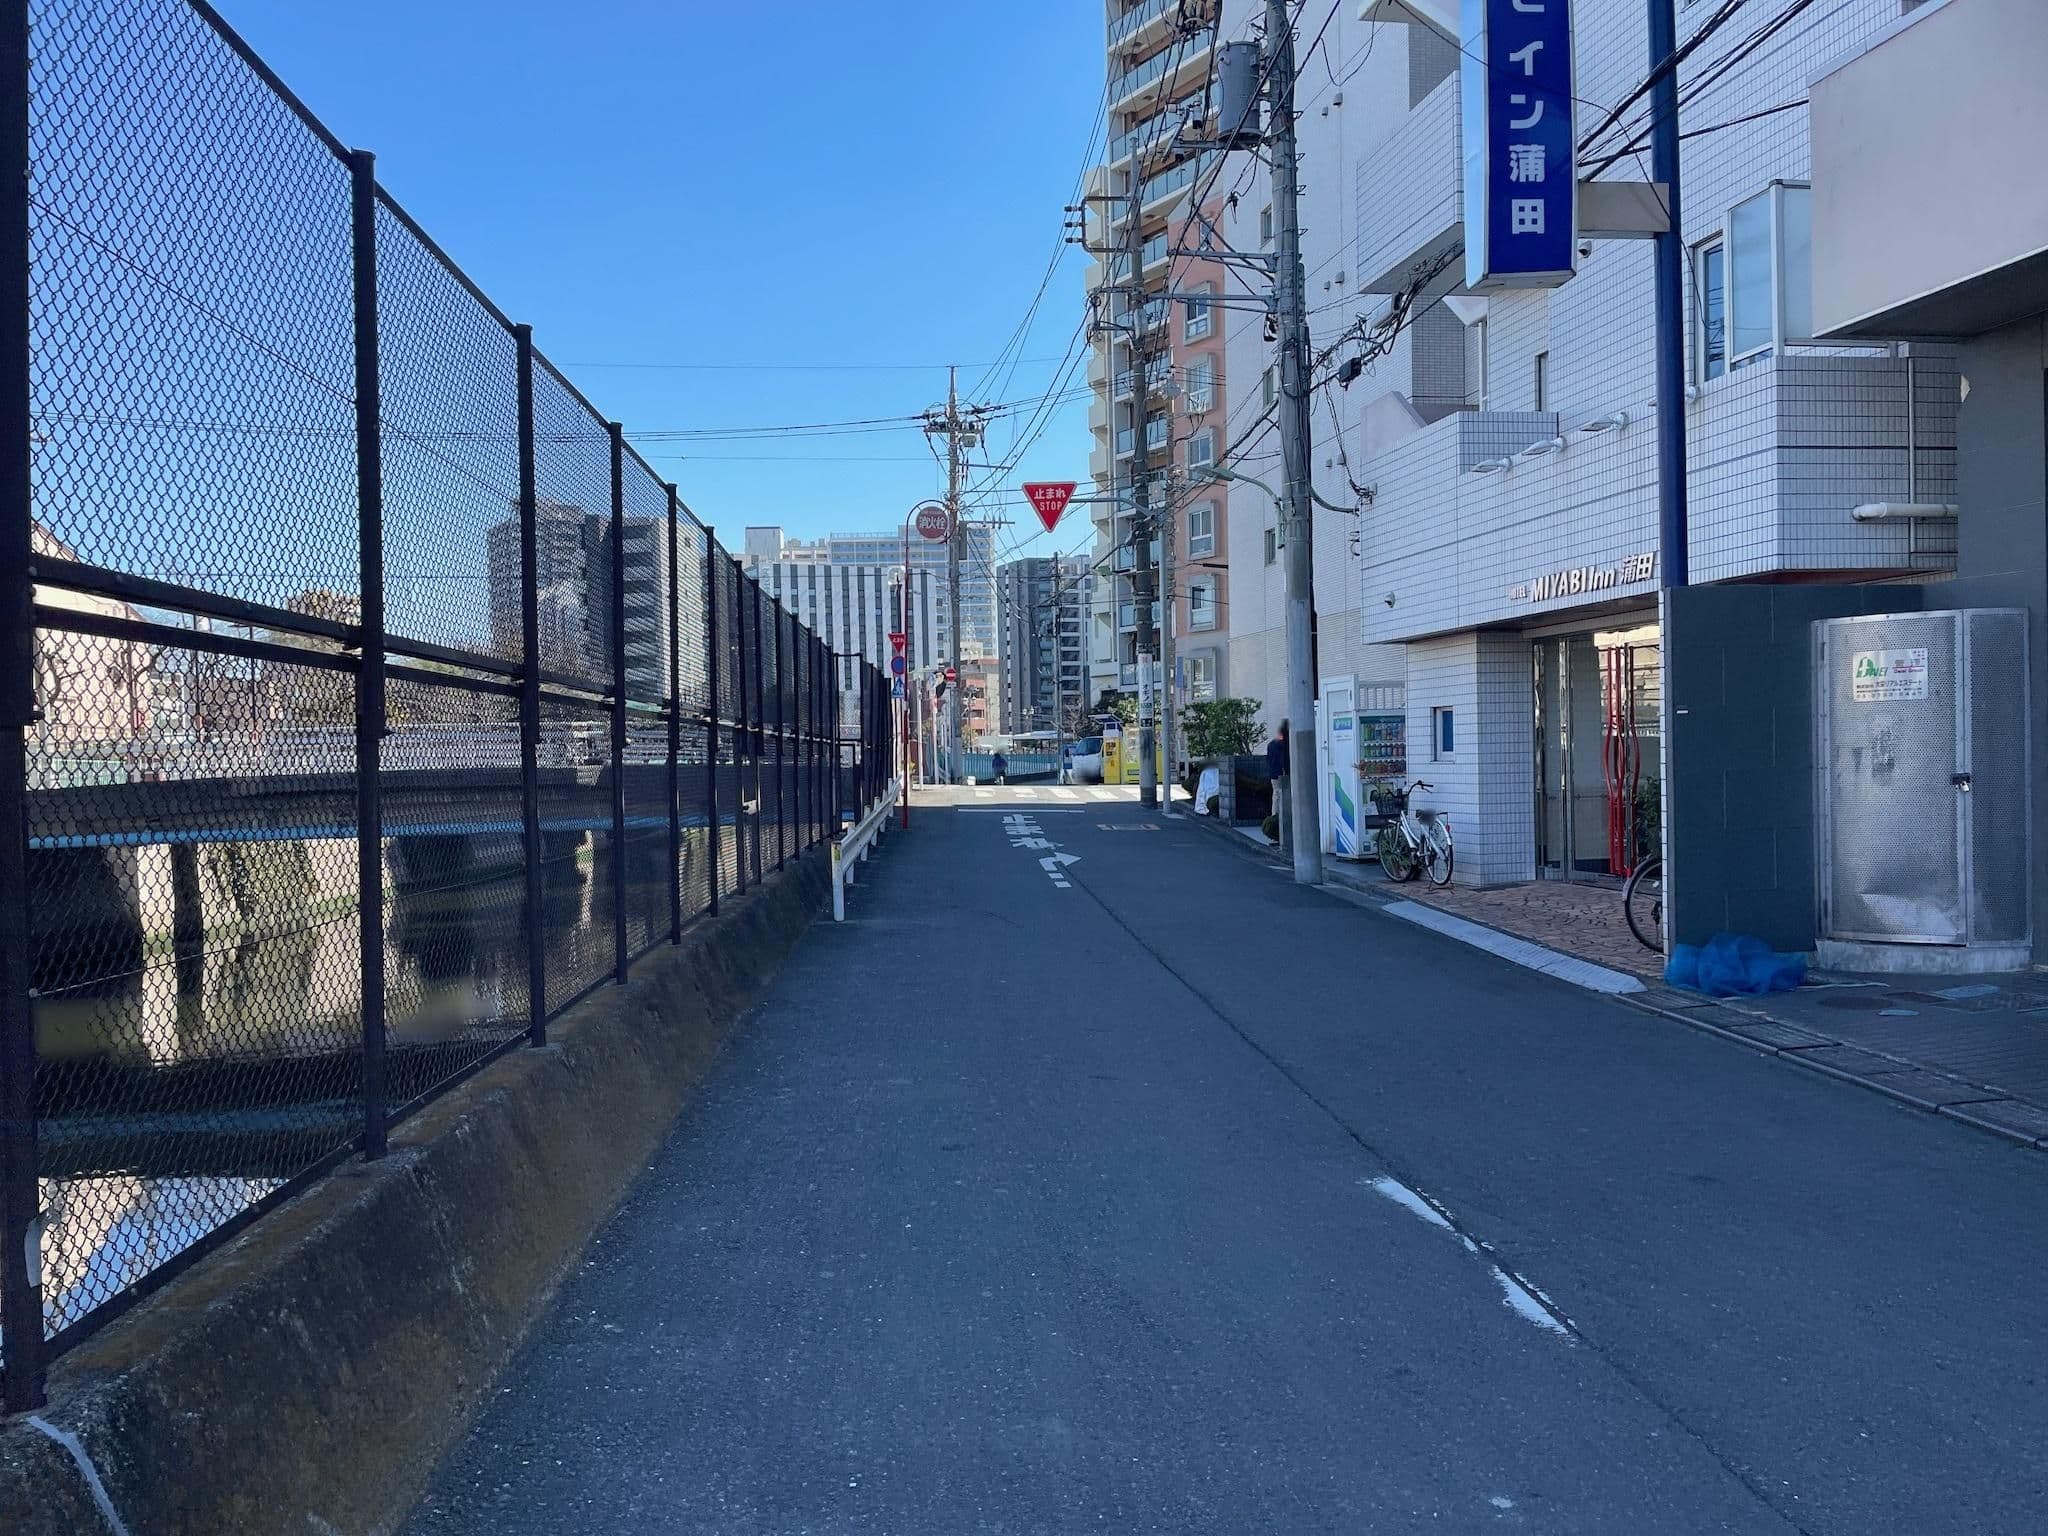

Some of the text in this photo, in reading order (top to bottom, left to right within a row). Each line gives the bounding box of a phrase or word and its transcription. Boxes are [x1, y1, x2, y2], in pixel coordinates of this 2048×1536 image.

[1034, 487, 1067, 500] 止まれ
[1040, 501, 1063, 511] STOP
[919, 515, 946, 530] 消火栓
[1532, 566, 1587, 602] MIYABI
[1588, 565, 1616, 590] Inn
[1619, 552, 1655, 584] 蒲田
[1001, 813, 1064, 849] 止まれ
